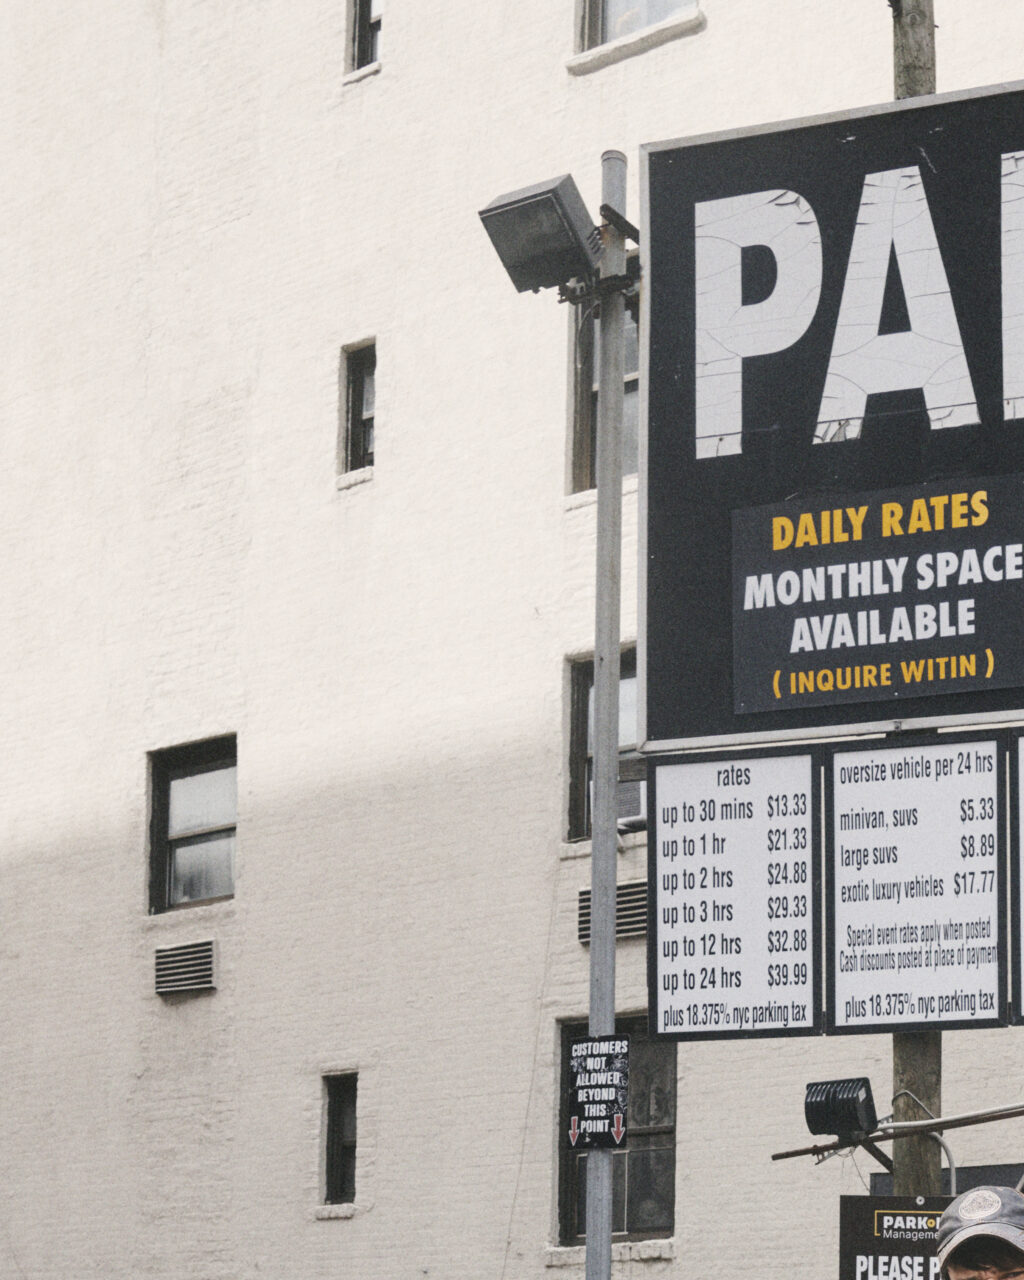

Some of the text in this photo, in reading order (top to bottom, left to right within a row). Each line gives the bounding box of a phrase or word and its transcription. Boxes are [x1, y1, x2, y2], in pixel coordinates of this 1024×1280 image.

[772, 490, 988, 550] DAILY RATES
[744, 544, 1022, 610] MONTHLY SPACE
[790, 599, 975, 653] AVAILABLE
[790, 654, 976, 694] INQUIRE WITIN
[718, 766, 750, 786] rates
[840, 752, 992, 784] oversize vehicle per 24 hrs
[663, 793, 806, 826] up to 30 mins $13.33
[840, 797, 994, 831] minivan, suvs $5.33
[664, 1002, 806, 1032] plus 18.375% nyc parking tax
[572, 1041, 628, 1057] CUSTOMERS
[587, 1057, 606, 1070] NOT
[576, 1072, 620, 1086] ALLOWED
[578, 1088, 615, 1102] BEYOND
[585, 1104, 606, 1117] THIS
[581, 1120, 609, 1133] POINT
[883, 1229, 939, 1241] Manageme
